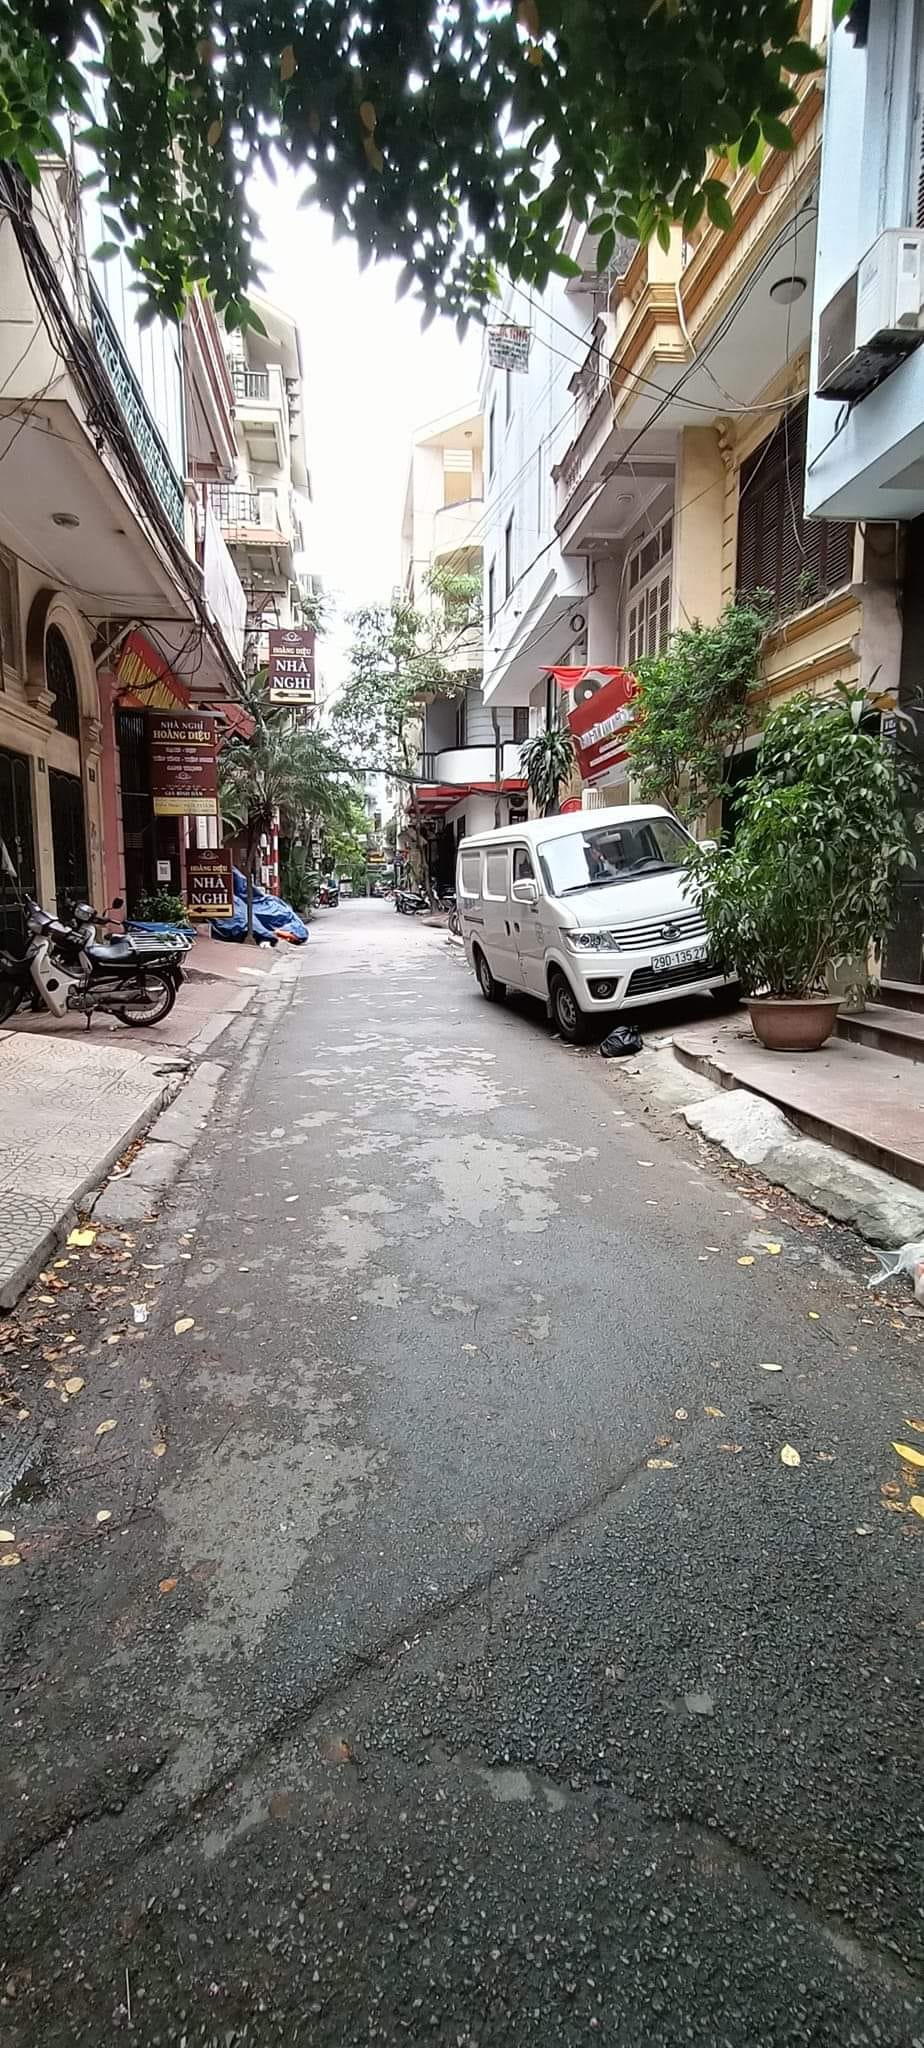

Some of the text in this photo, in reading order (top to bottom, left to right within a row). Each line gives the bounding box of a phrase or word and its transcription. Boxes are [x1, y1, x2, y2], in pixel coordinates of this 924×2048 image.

[276, 657, 308, 672] NHÀ
[273, 673, 311, 689] NGHỈ
[160, 719, 204, 729] NHÀ NGHỈ
[153, 728, 211, 742] HOÀNG DIỆU
[193, 874, 225, 888] NHÀ
[191, 889, 228, 904] NGHỈ
